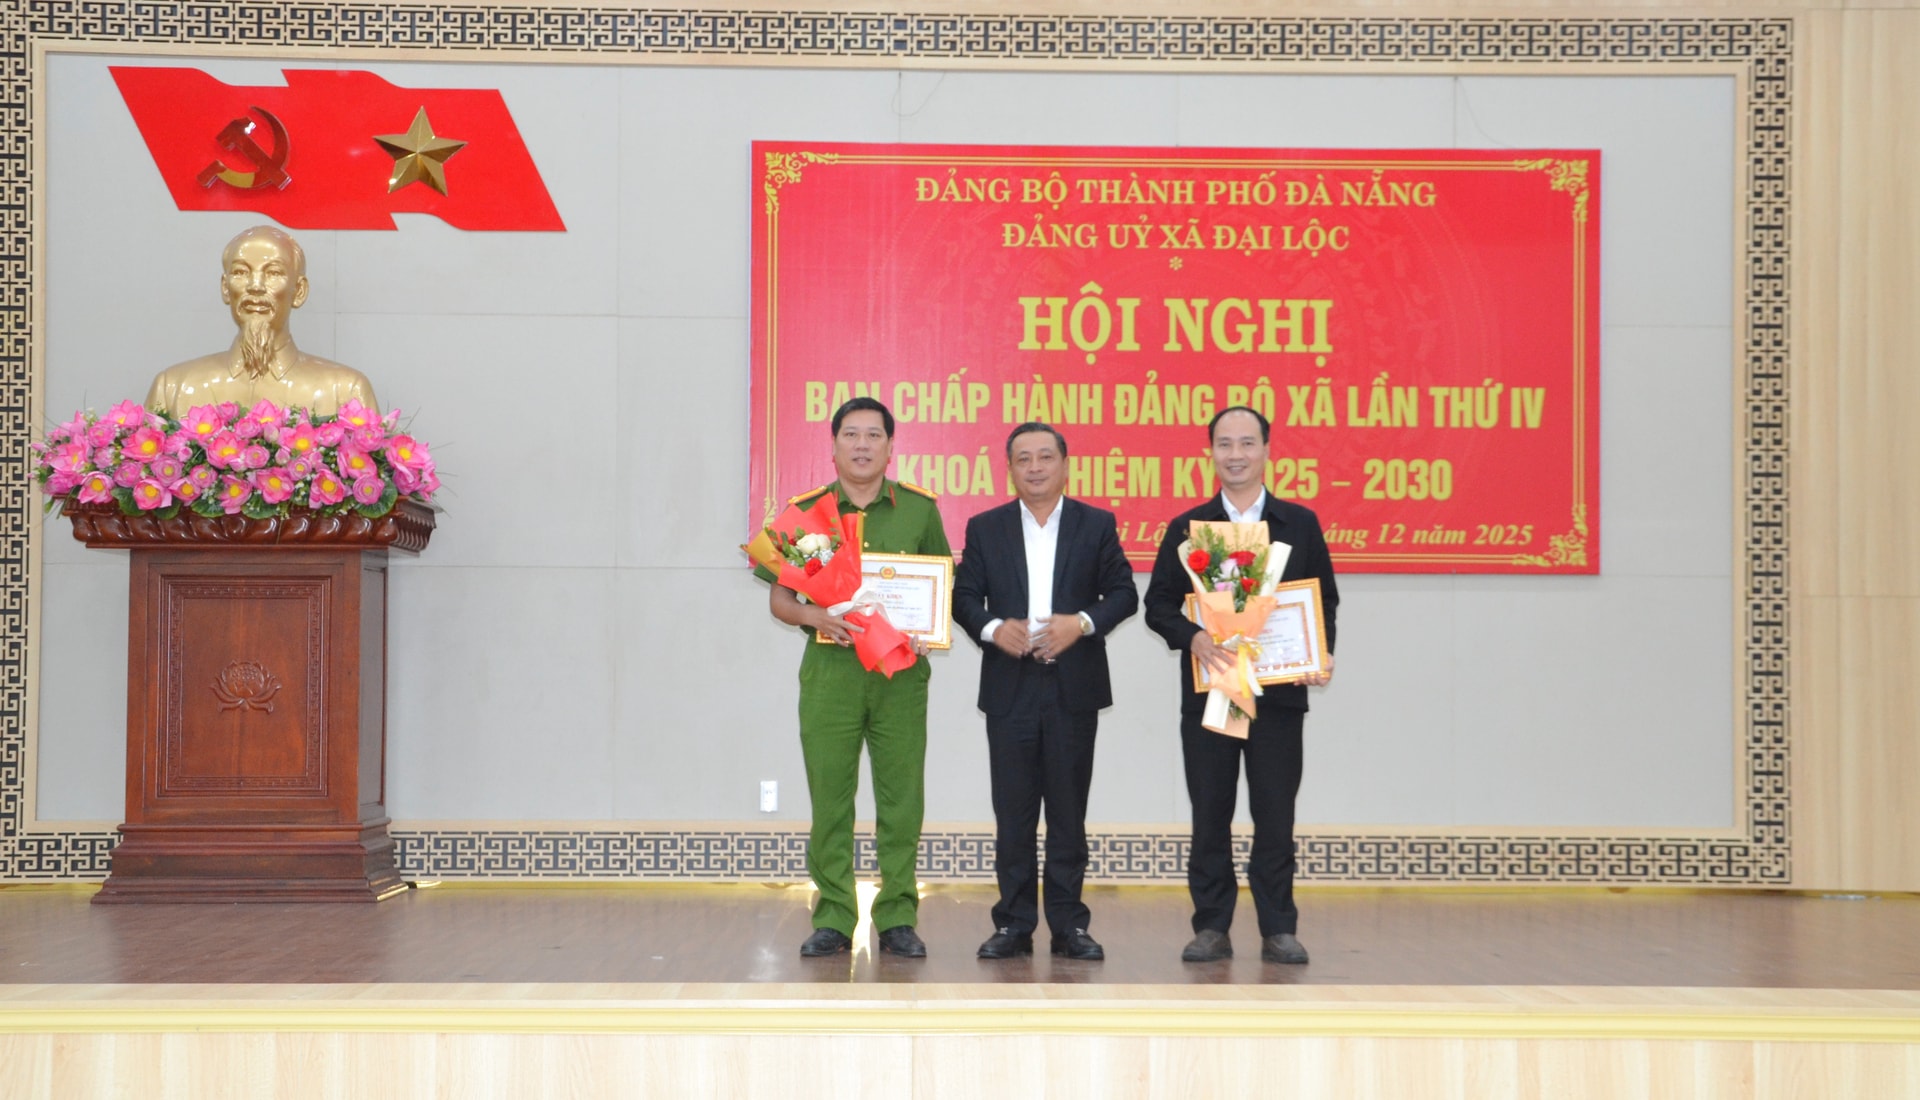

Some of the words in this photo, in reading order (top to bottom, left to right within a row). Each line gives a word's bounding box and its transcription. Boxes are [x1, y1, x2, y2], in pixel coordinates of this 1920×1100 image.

[916, 168, 1011, 202] ĐẢNG
[1021, 171, 1067, 210] BỘ
[1076, 172, 1195, 205] THÀNH
[1206, 171, 1277, 206] PHỐ
[1285, 174, 1332, 206] ĐÀ
[1340, 169, 1437, 207] NẴNG
[1002, 213, 1098, 248] ĐẢNG
[1108, 215, 1153, 249] UỶ
[1160, 219, 1205, 249] XÃ
[1213, 225, 1271, 256] ĐẠI
[1281, 218, 1350, 258] LỘC
[1017, 280, 1141, 365] HỘI
[1163, 297, 1333, 368] NGHỊ
[893, 367, 991, 424] CHẤP
[1002, 375, 1103, 425] HÀNH
[1113, 370, 1215, 426] ĐẢNG
[1286, 378, 1337, 427] XÃ
[1347, 372, 1418, 428] LẦN
[1429, 379, 1504, 428] THỨ
[1511, 387, 1545, 429] IV
[896, 446, 995, 496] KHOÁ
[1063, 447, 1161, 507] HIỆM
[1363, 458, 1452, 501] 2030
[1135, 521, 1167, 548] Lộ
[1323, 522, 1369, 549] áng
[1378, 523, 1406, 544] 12
[1412, 525, 1467, 544] năm
[1473, 524, 1534, 546] 2025
